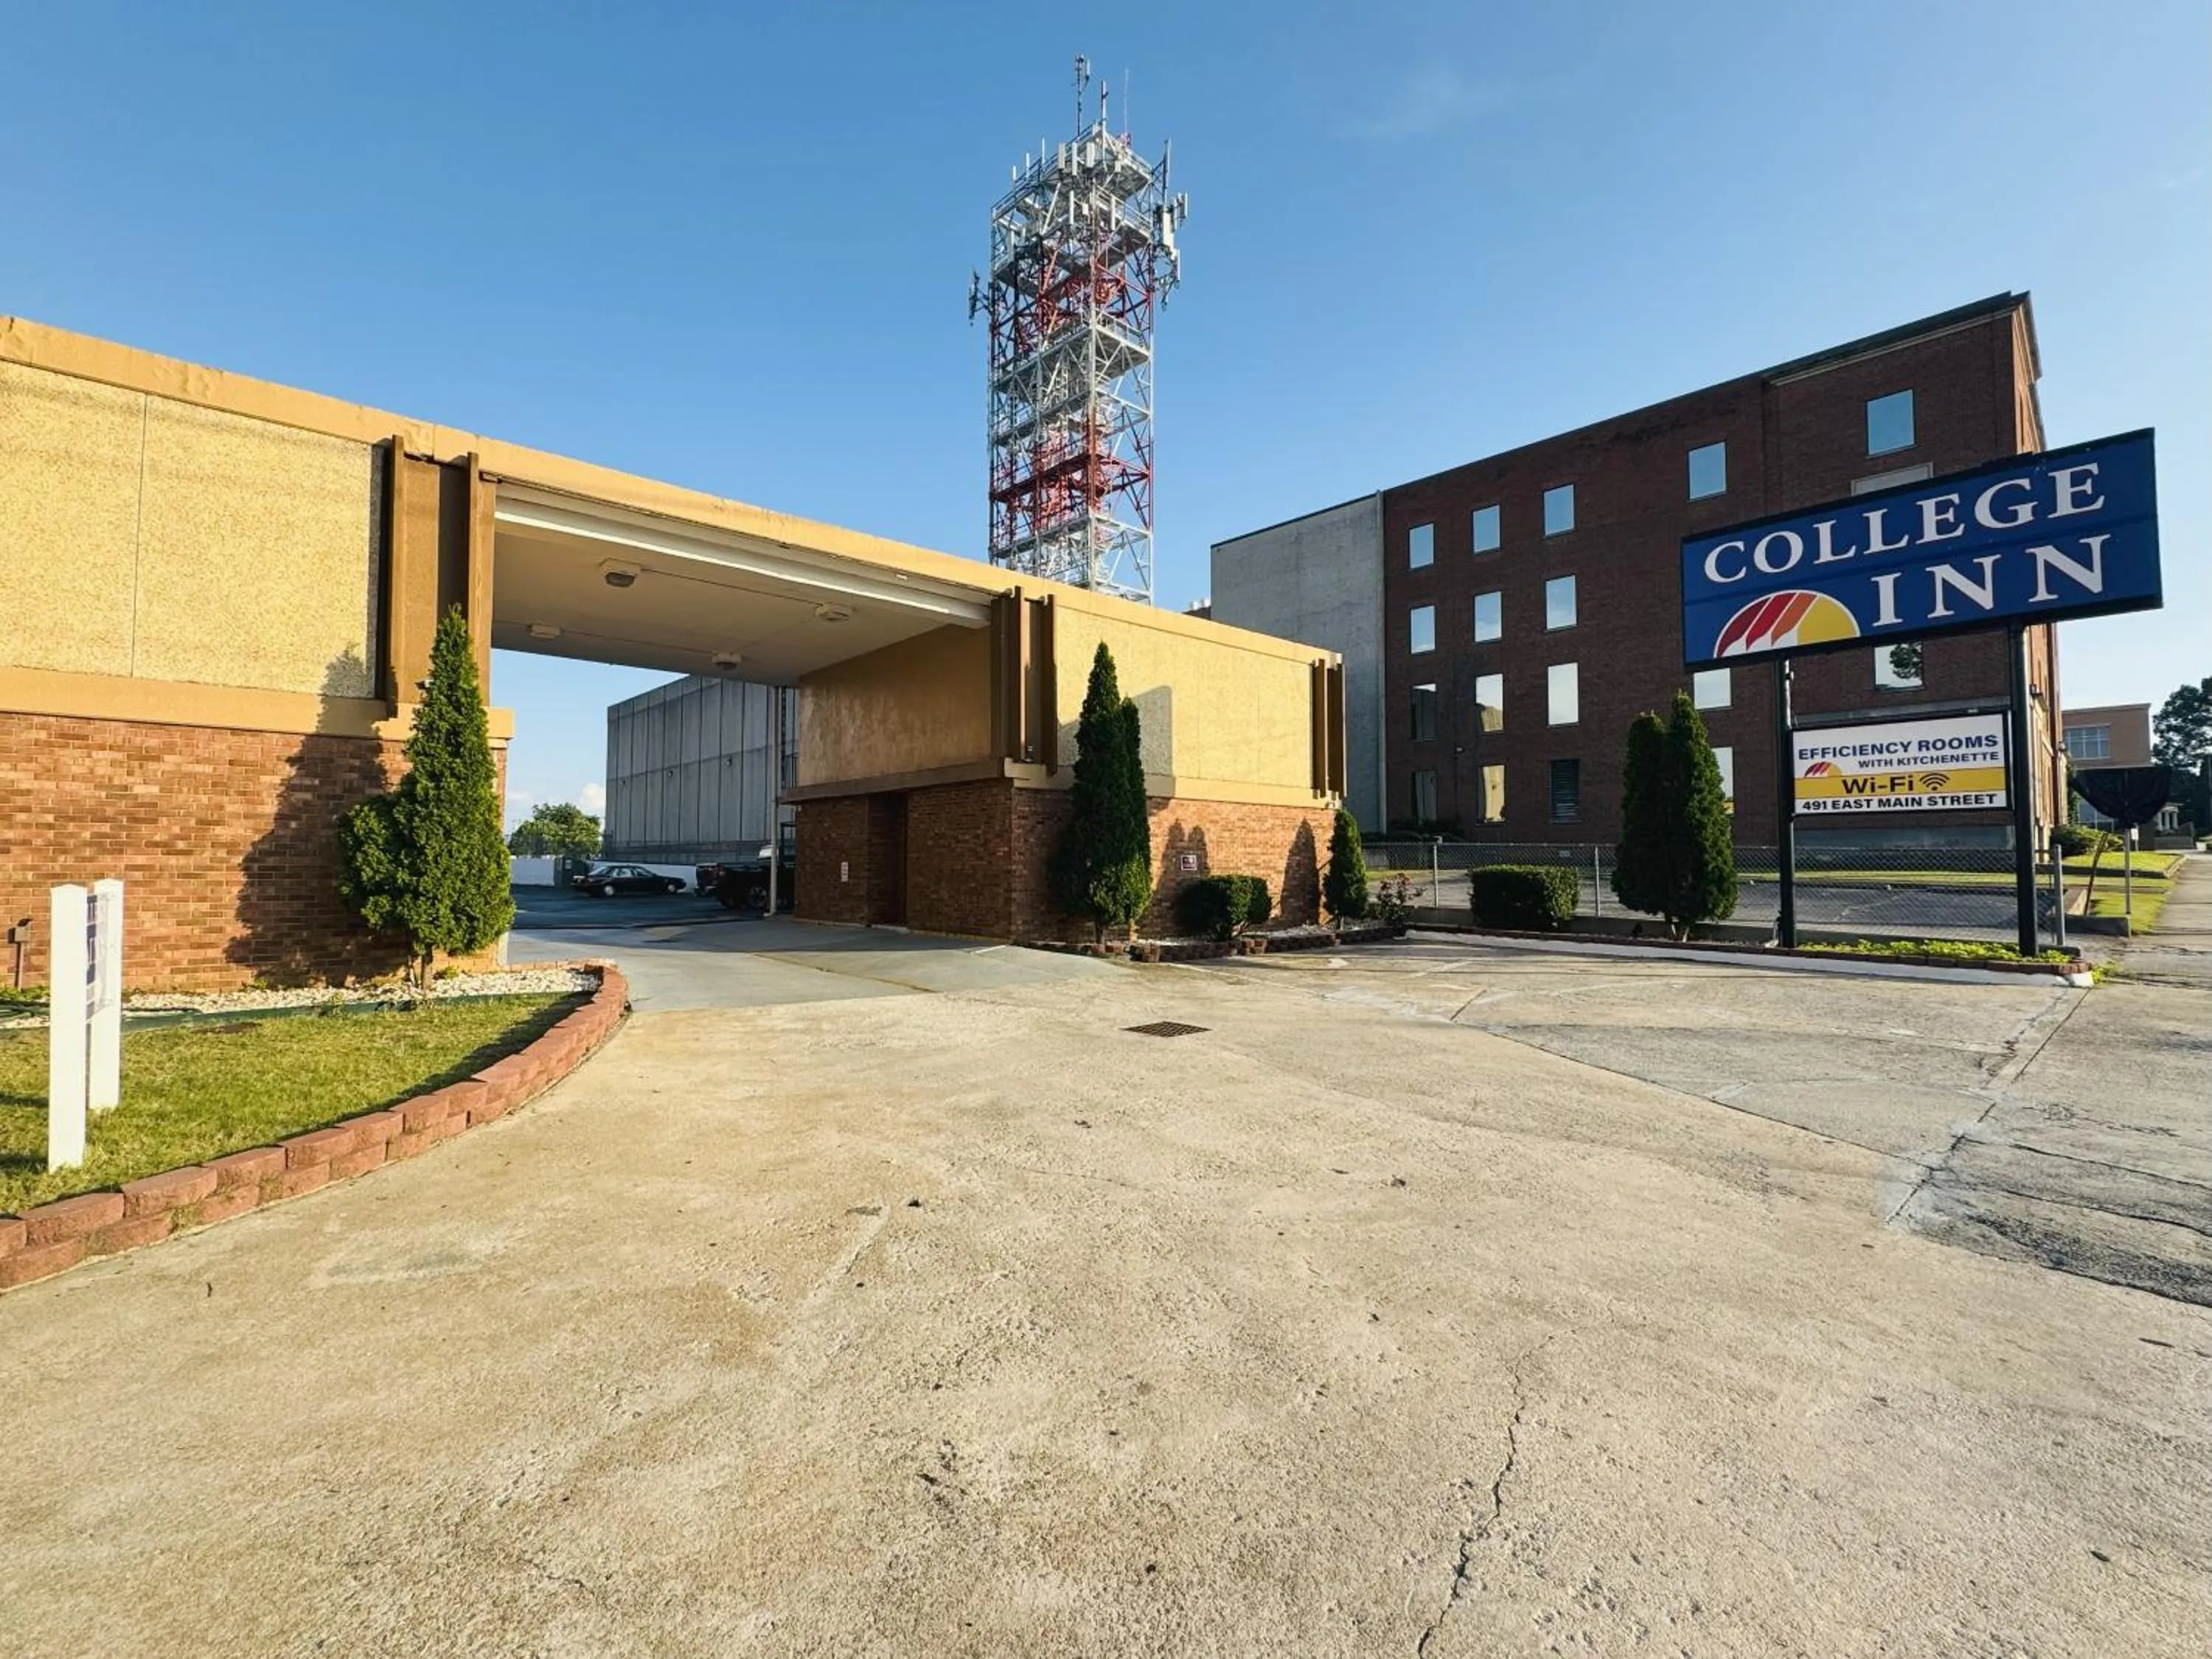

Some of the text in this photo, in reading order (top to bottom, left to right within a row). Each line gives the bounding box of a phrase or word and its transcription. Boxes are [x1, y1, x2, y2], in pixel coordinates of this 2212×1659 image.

[1704, 462, 2105, 584] COLLEGE
[1871, 534, 2112, 627] INN
[1798, 734, 1998, 759] EFFICIENCY ROOMS
[1858, 752, 2000, 768] WITH KITCHENETTE
[1842, 775, 1914, 794] Wi-Fi
[1802, 794, 1997, 810] 491 EAST MAIN STREET
